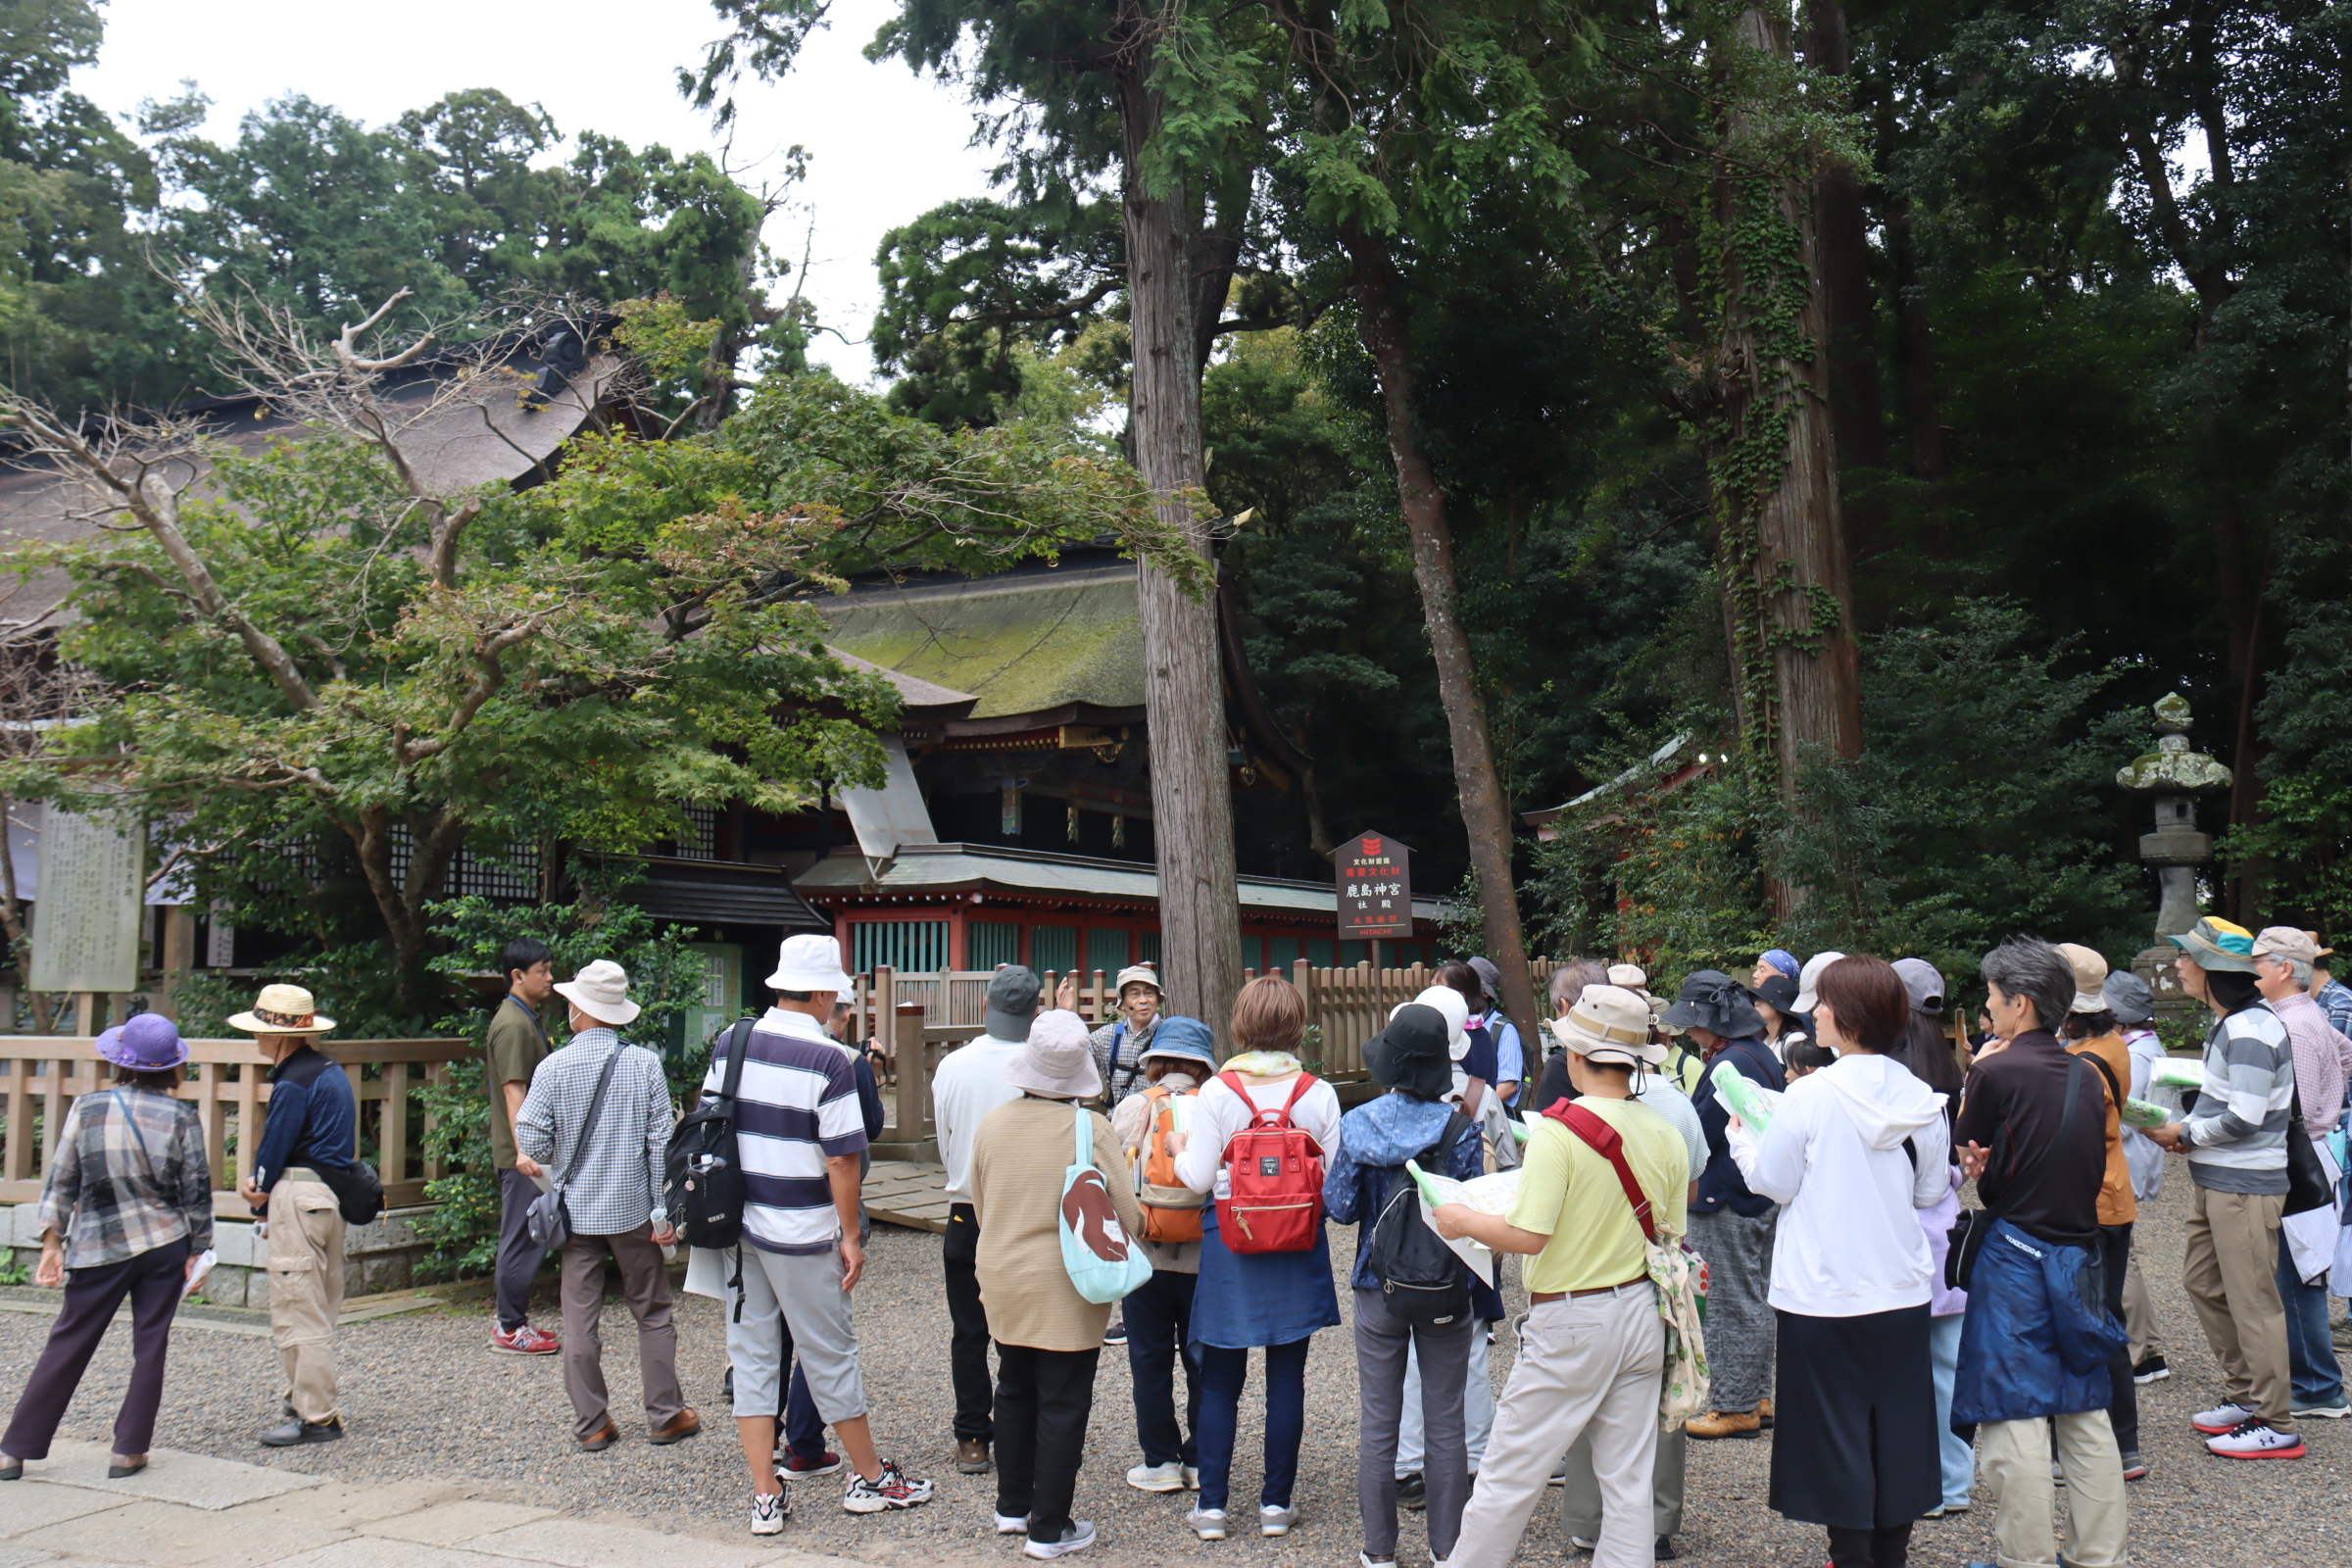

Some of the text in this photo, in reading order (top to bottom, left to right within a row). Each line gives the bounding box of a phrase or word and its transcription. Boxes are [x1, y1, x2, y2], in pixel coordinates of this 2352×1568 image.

[1346, 866, 1400, 877] 重要文化財
[1346, 882, 1401, 898] 鹿島神宮
